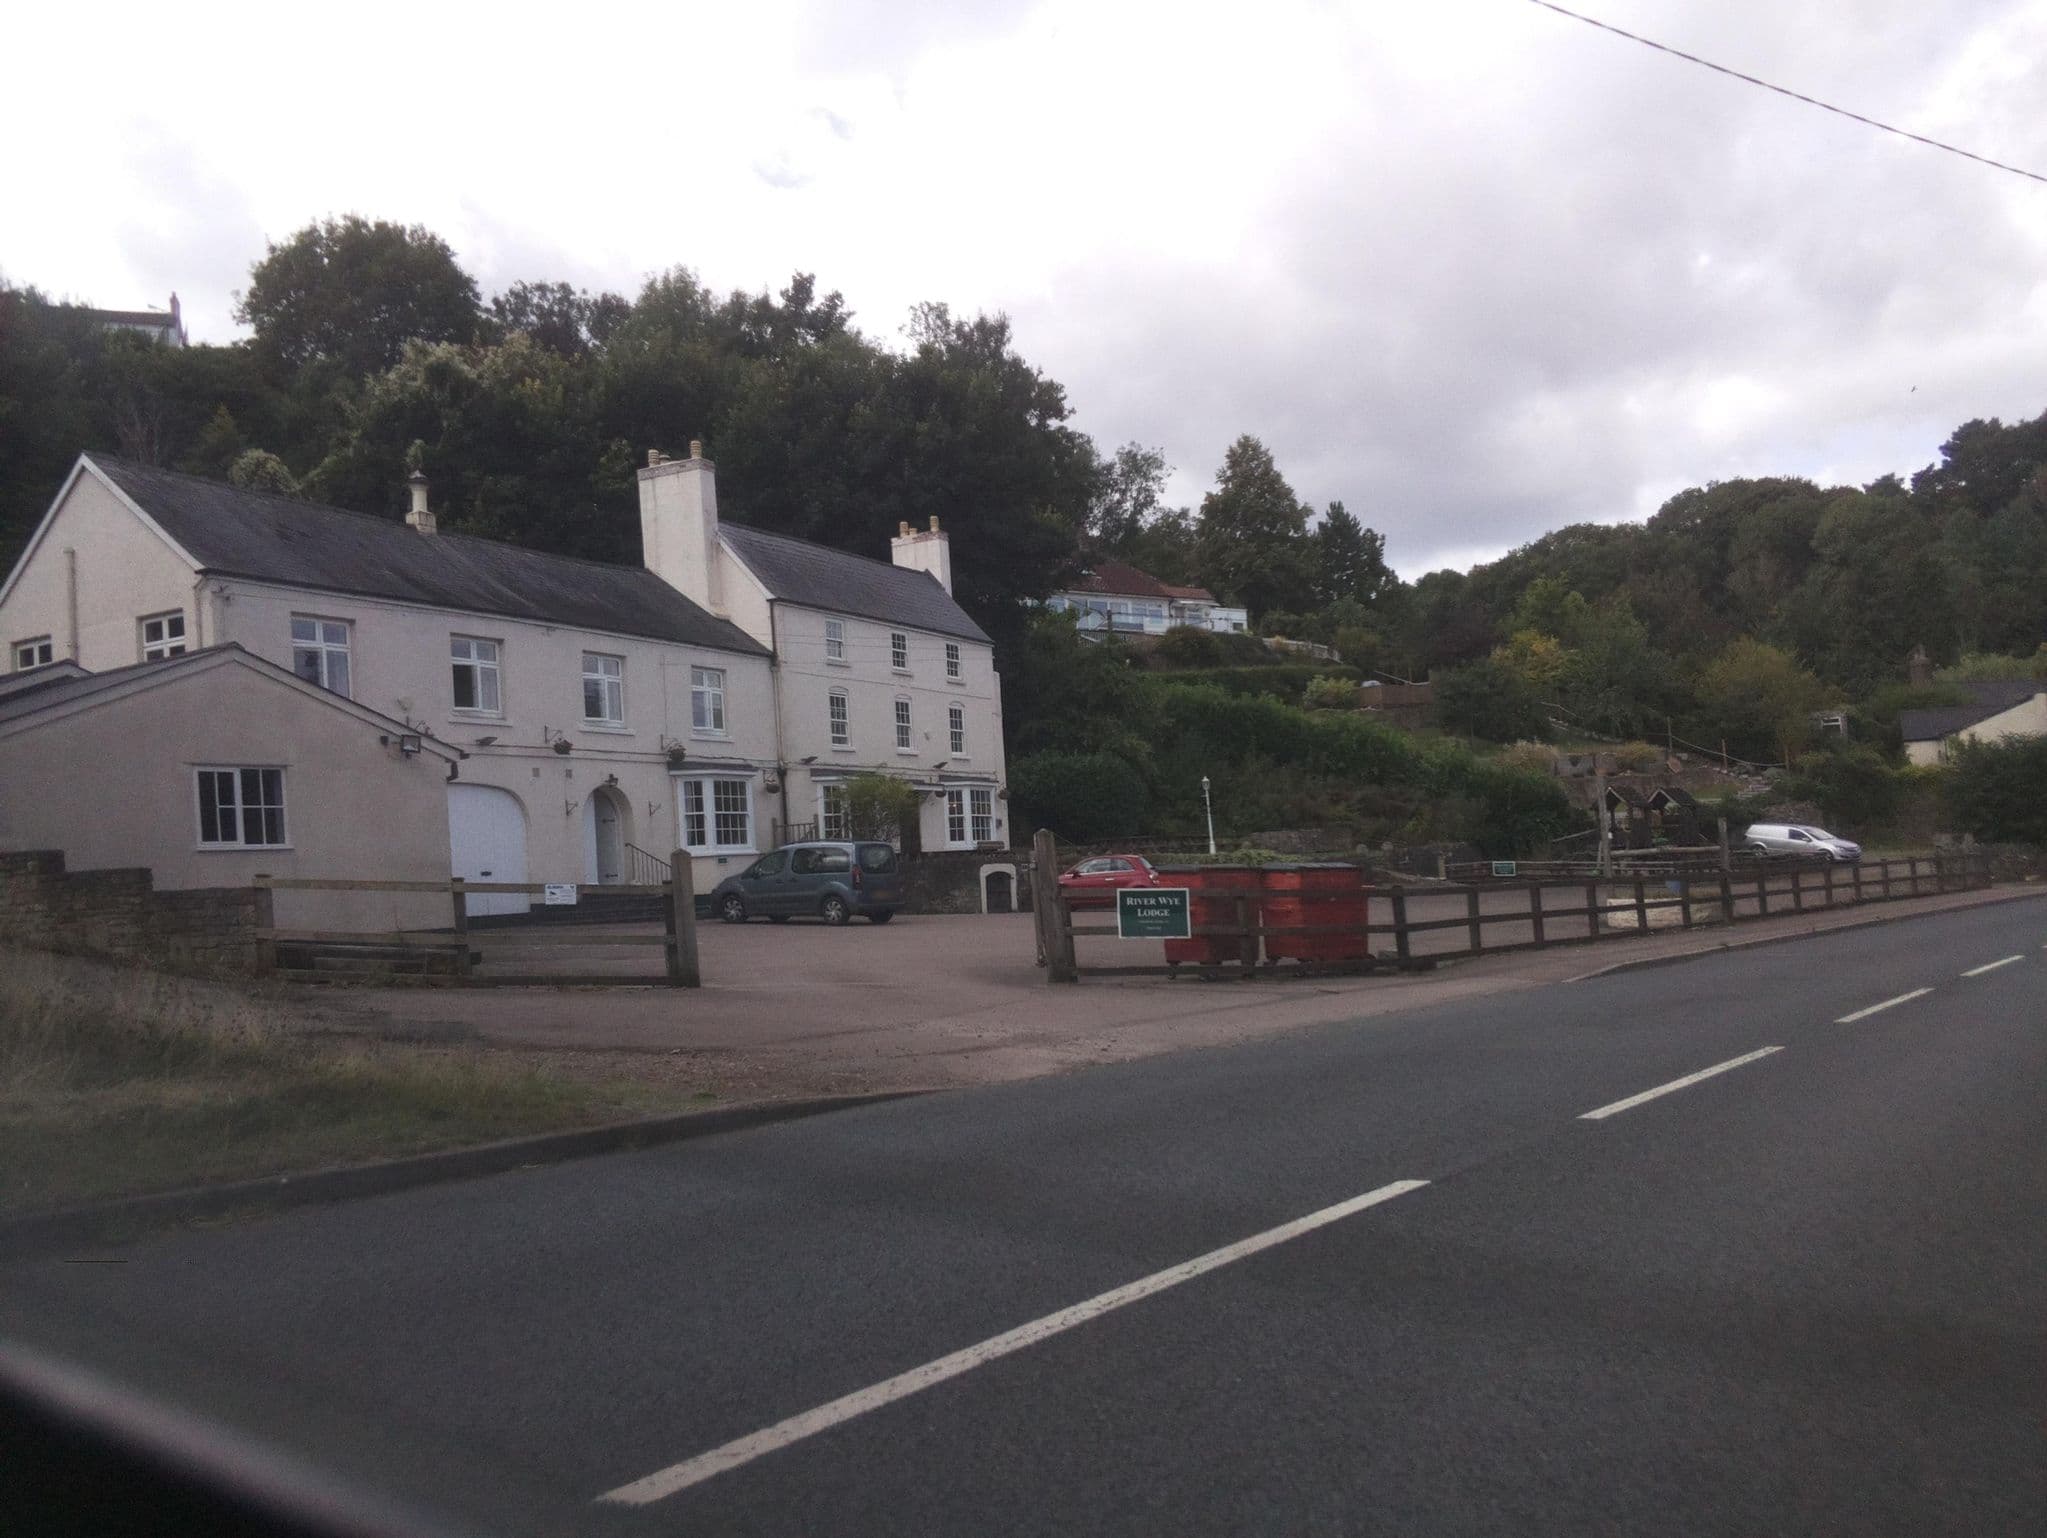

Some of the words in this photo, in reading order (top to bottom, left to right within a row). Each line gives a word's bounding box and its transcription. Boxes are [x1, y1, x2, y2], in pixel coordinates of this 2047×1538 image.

[1126, 897, 1157, 906] RIVER
[1158, 896, 1181, 905] WYE
[1137, 908, 1170, 917] LODGE
